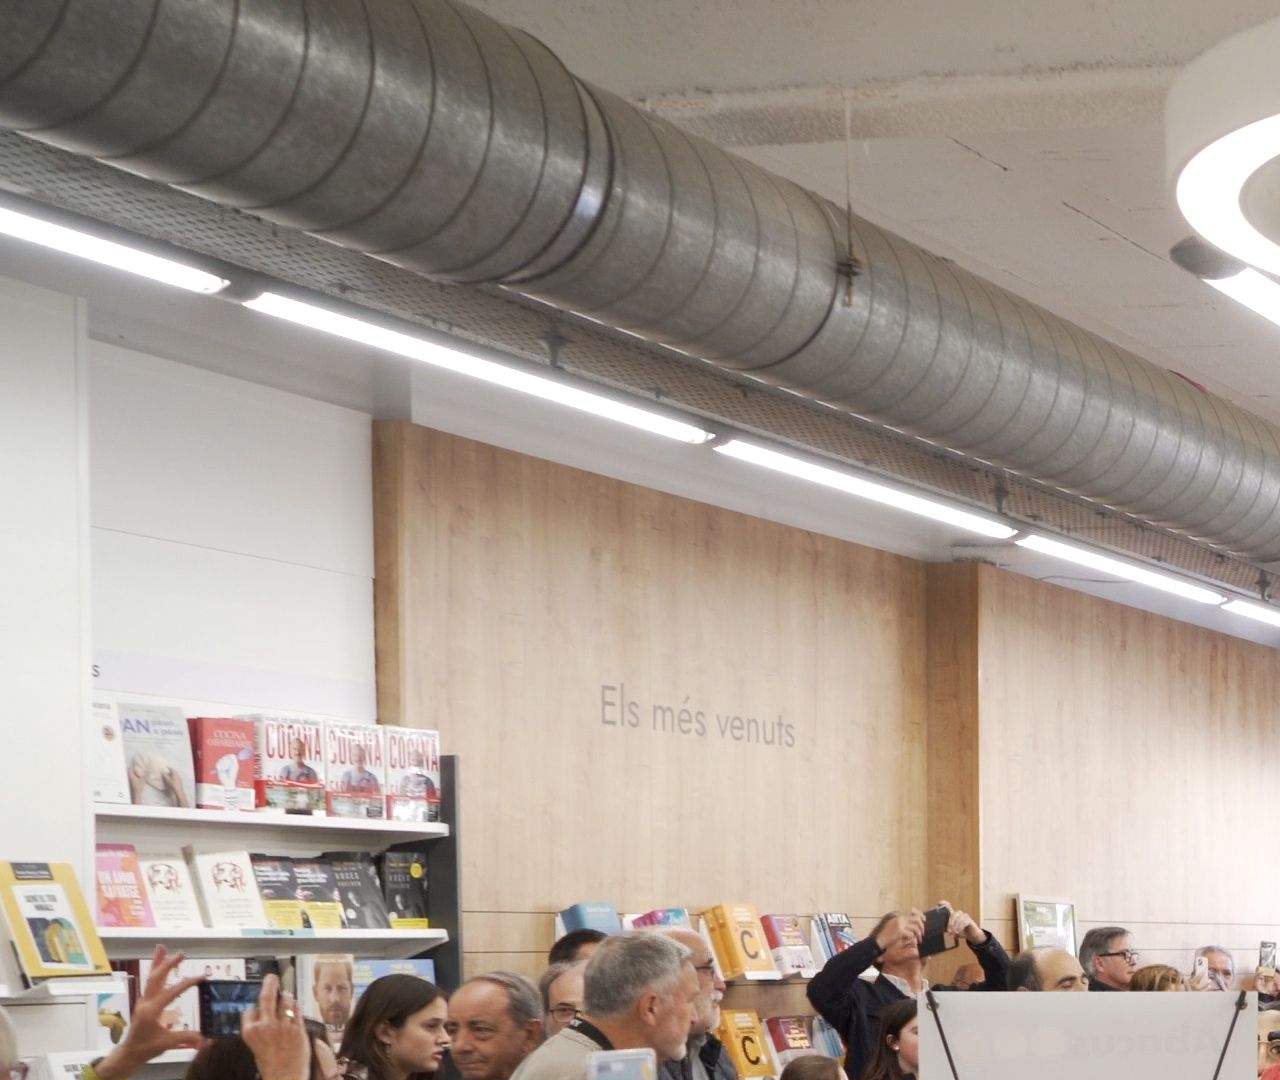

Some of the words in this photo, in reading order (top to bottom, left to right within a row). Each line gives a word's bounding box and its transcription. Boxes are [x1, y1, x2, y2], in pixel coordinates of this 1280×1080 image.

[120, 718, 151, 734] AN
[600, 683, 640, 728] Els
[652, 697, 707, 737] més
[716, 713, 796, 748] venuts
